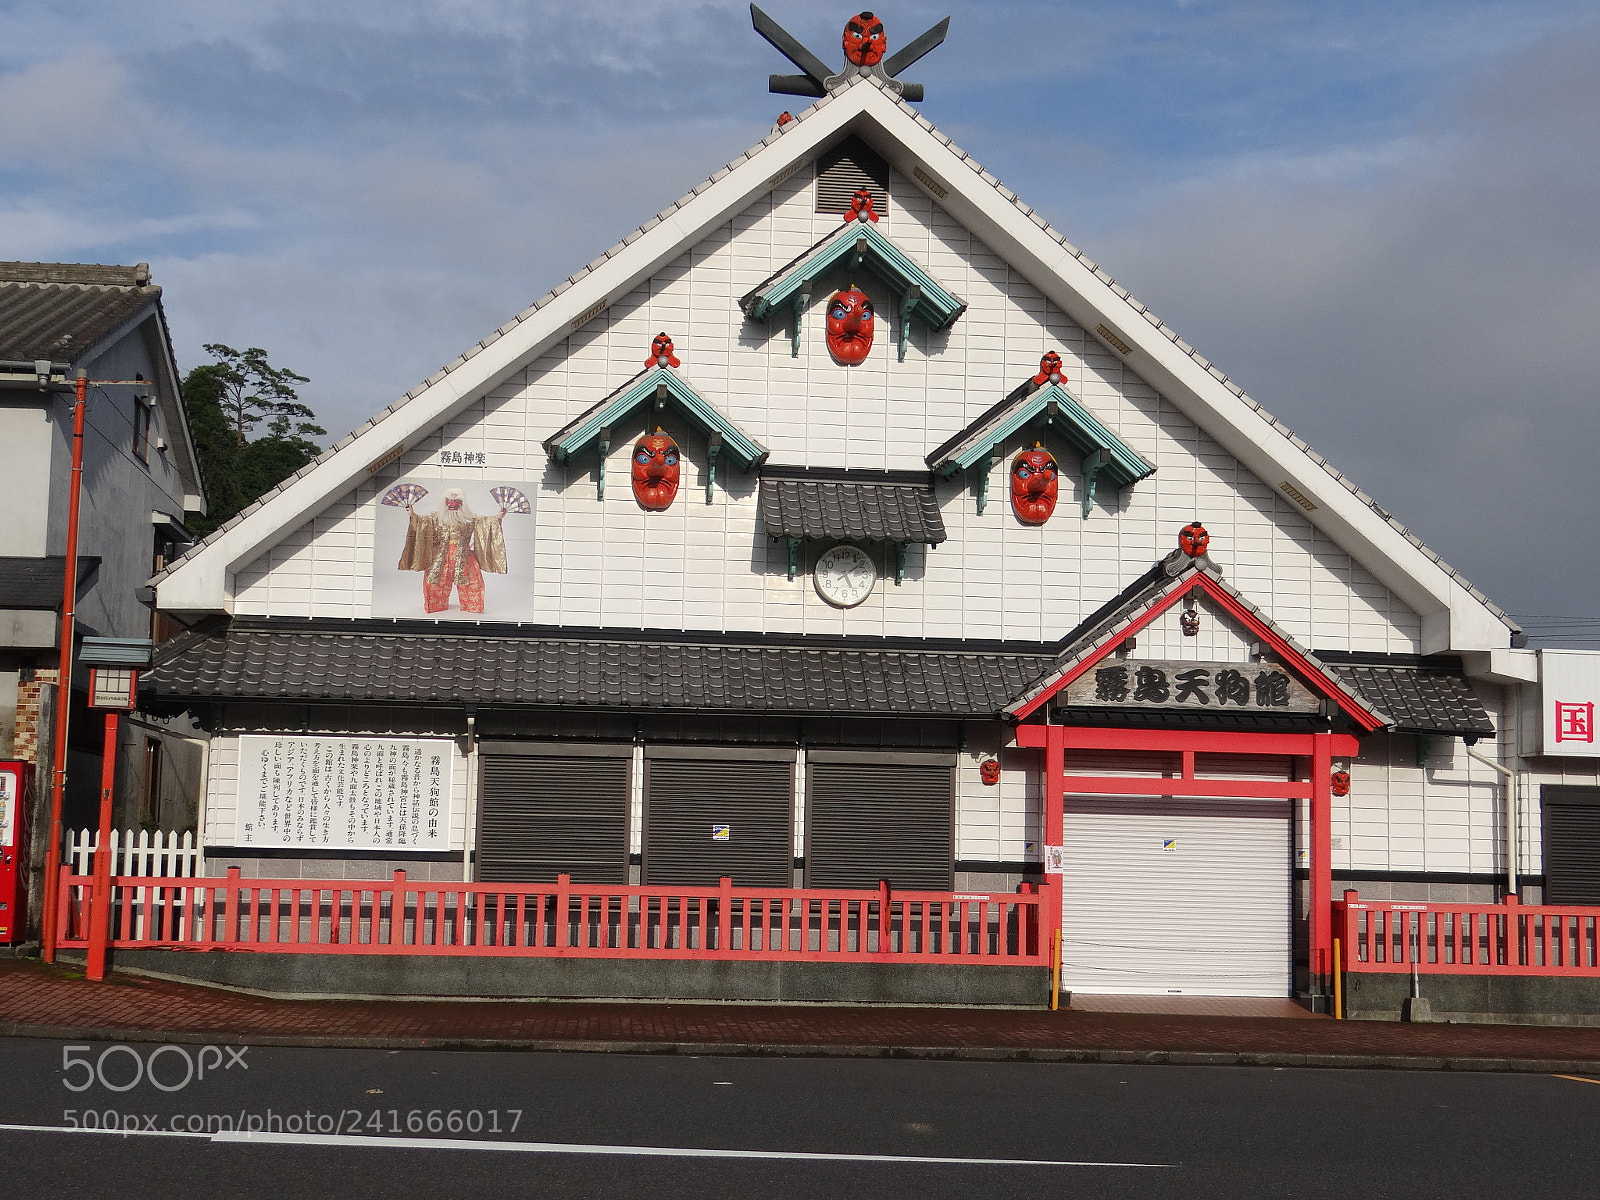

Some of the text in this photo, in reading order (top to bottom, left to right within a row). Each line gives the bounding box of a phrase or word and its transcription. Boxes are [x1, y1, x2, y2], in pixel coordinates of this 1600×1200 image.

[440, 450, 486, 465] 霧島神楽
[833, 553, 840, 562] 11
[842, 551, 851, 559] 12
[852, 554, 857, 563] 1
[825, 560, 834, 569] 10
[859, 560, 865, 569] 2
[822, 570, 829, 579] 9
[862, 570, 869, 579] 3
[825, 580, 832, 588] 8
[858, 581, 865, 589] 4
[833, 587, 839, 595] 7
[841, 590, 848, 598] 6
[851, 588, 858, 596] 5
[1095, 665, 1291, 707] 霧島天狗館
[1555, 700, 1595, 744] 国
[427, 755, 441, 839] 霧島天狗館の由来
